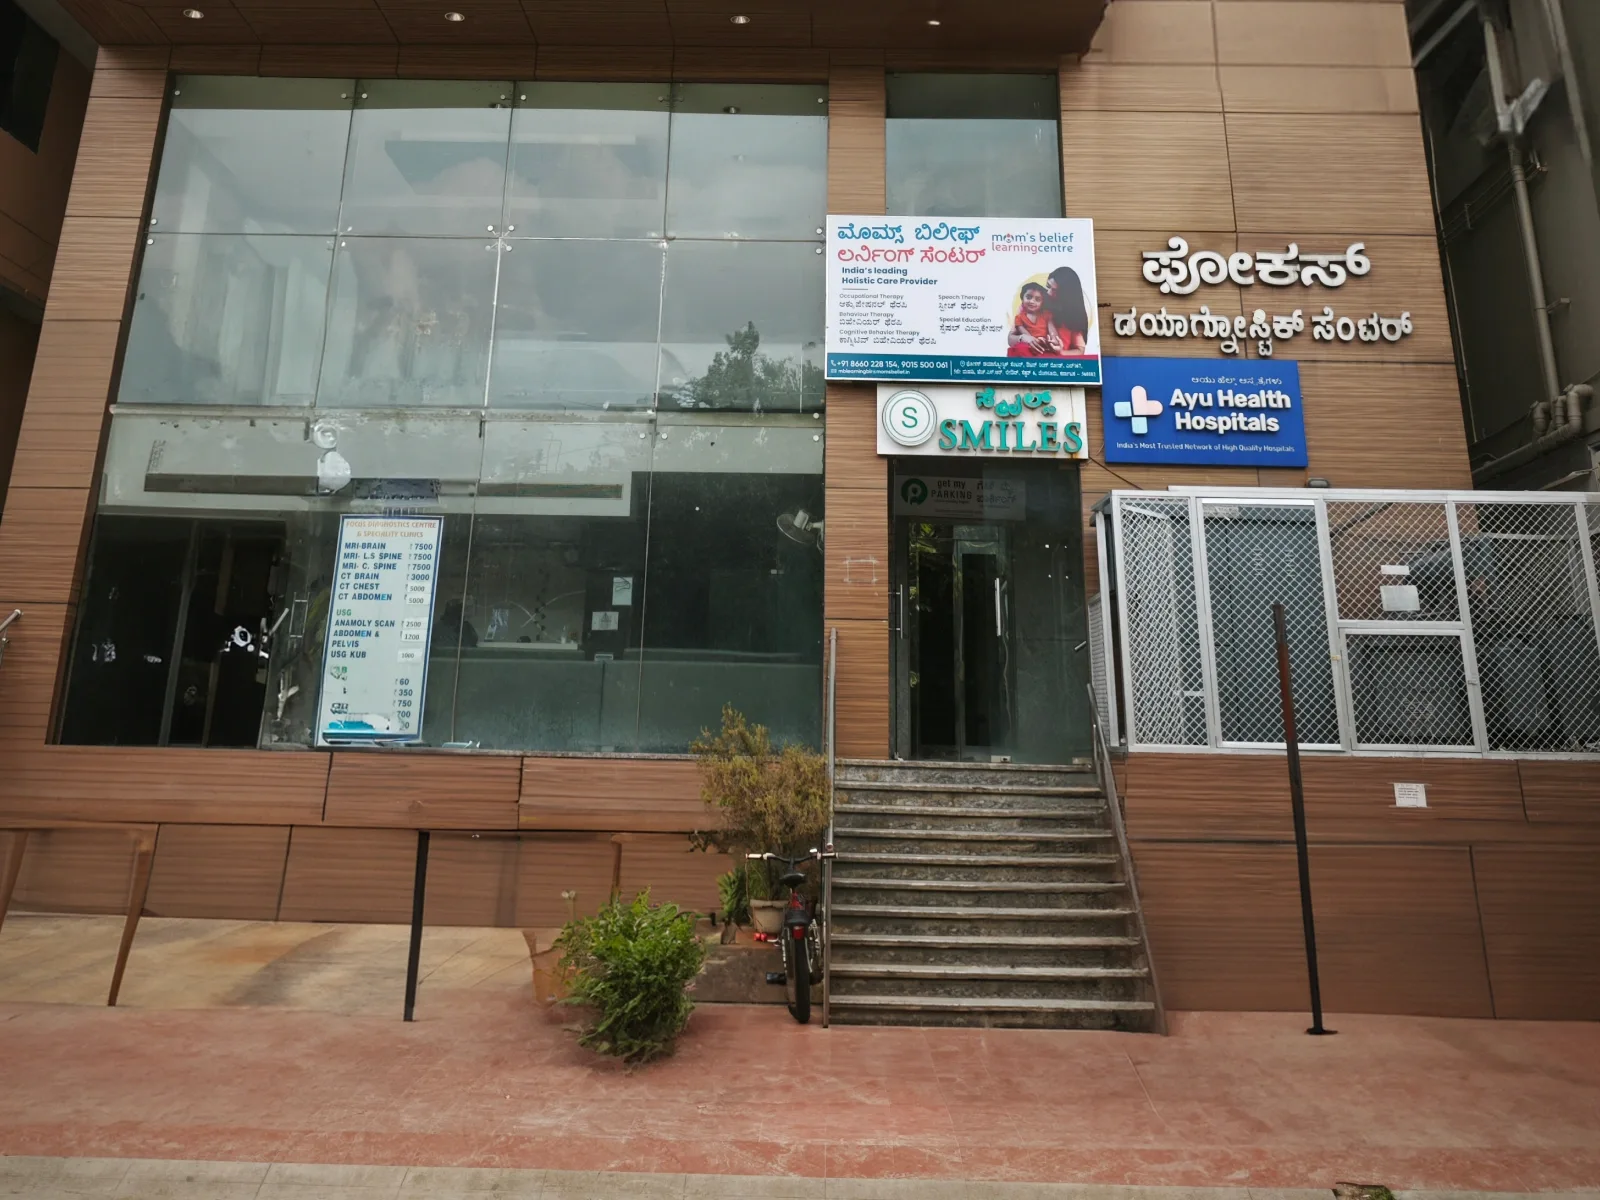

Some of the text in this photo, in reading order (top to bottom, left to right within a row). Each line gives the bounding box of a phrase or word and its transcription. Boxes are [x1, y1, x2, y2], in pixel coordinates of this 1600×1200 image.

[915, 222, 980, 244] ಬಿಲೀಫ್
[992, 232, 1074, 243] mom's belief
[838, 245, 986, 263] ಲರ್ನಿಂಗ್ ಸೆಂಟರ್
[992, 242, 1073, 254] learningcentre
[874, 267, 908, 276] leading
[1141, 236, 1371, 295] ಫೋಕಸ್
[1312, 306, 1413, 342] ಸೆಂಟರ್
[1170, 388, 1291, 410] Ayu Health
[902, 407, 918, 428] S
[1175, 412, 1280, 434] Hospitals
[938, 418, 1083, 453] SMILES
[1222, 444, 1238, 452] High
[1239, 444, 1262, 452] Quality
[1264, 445, 1295, 453] Hospitals
[938, 480, 965, 489] get my
[931, 490, 972, 500] PARKING
